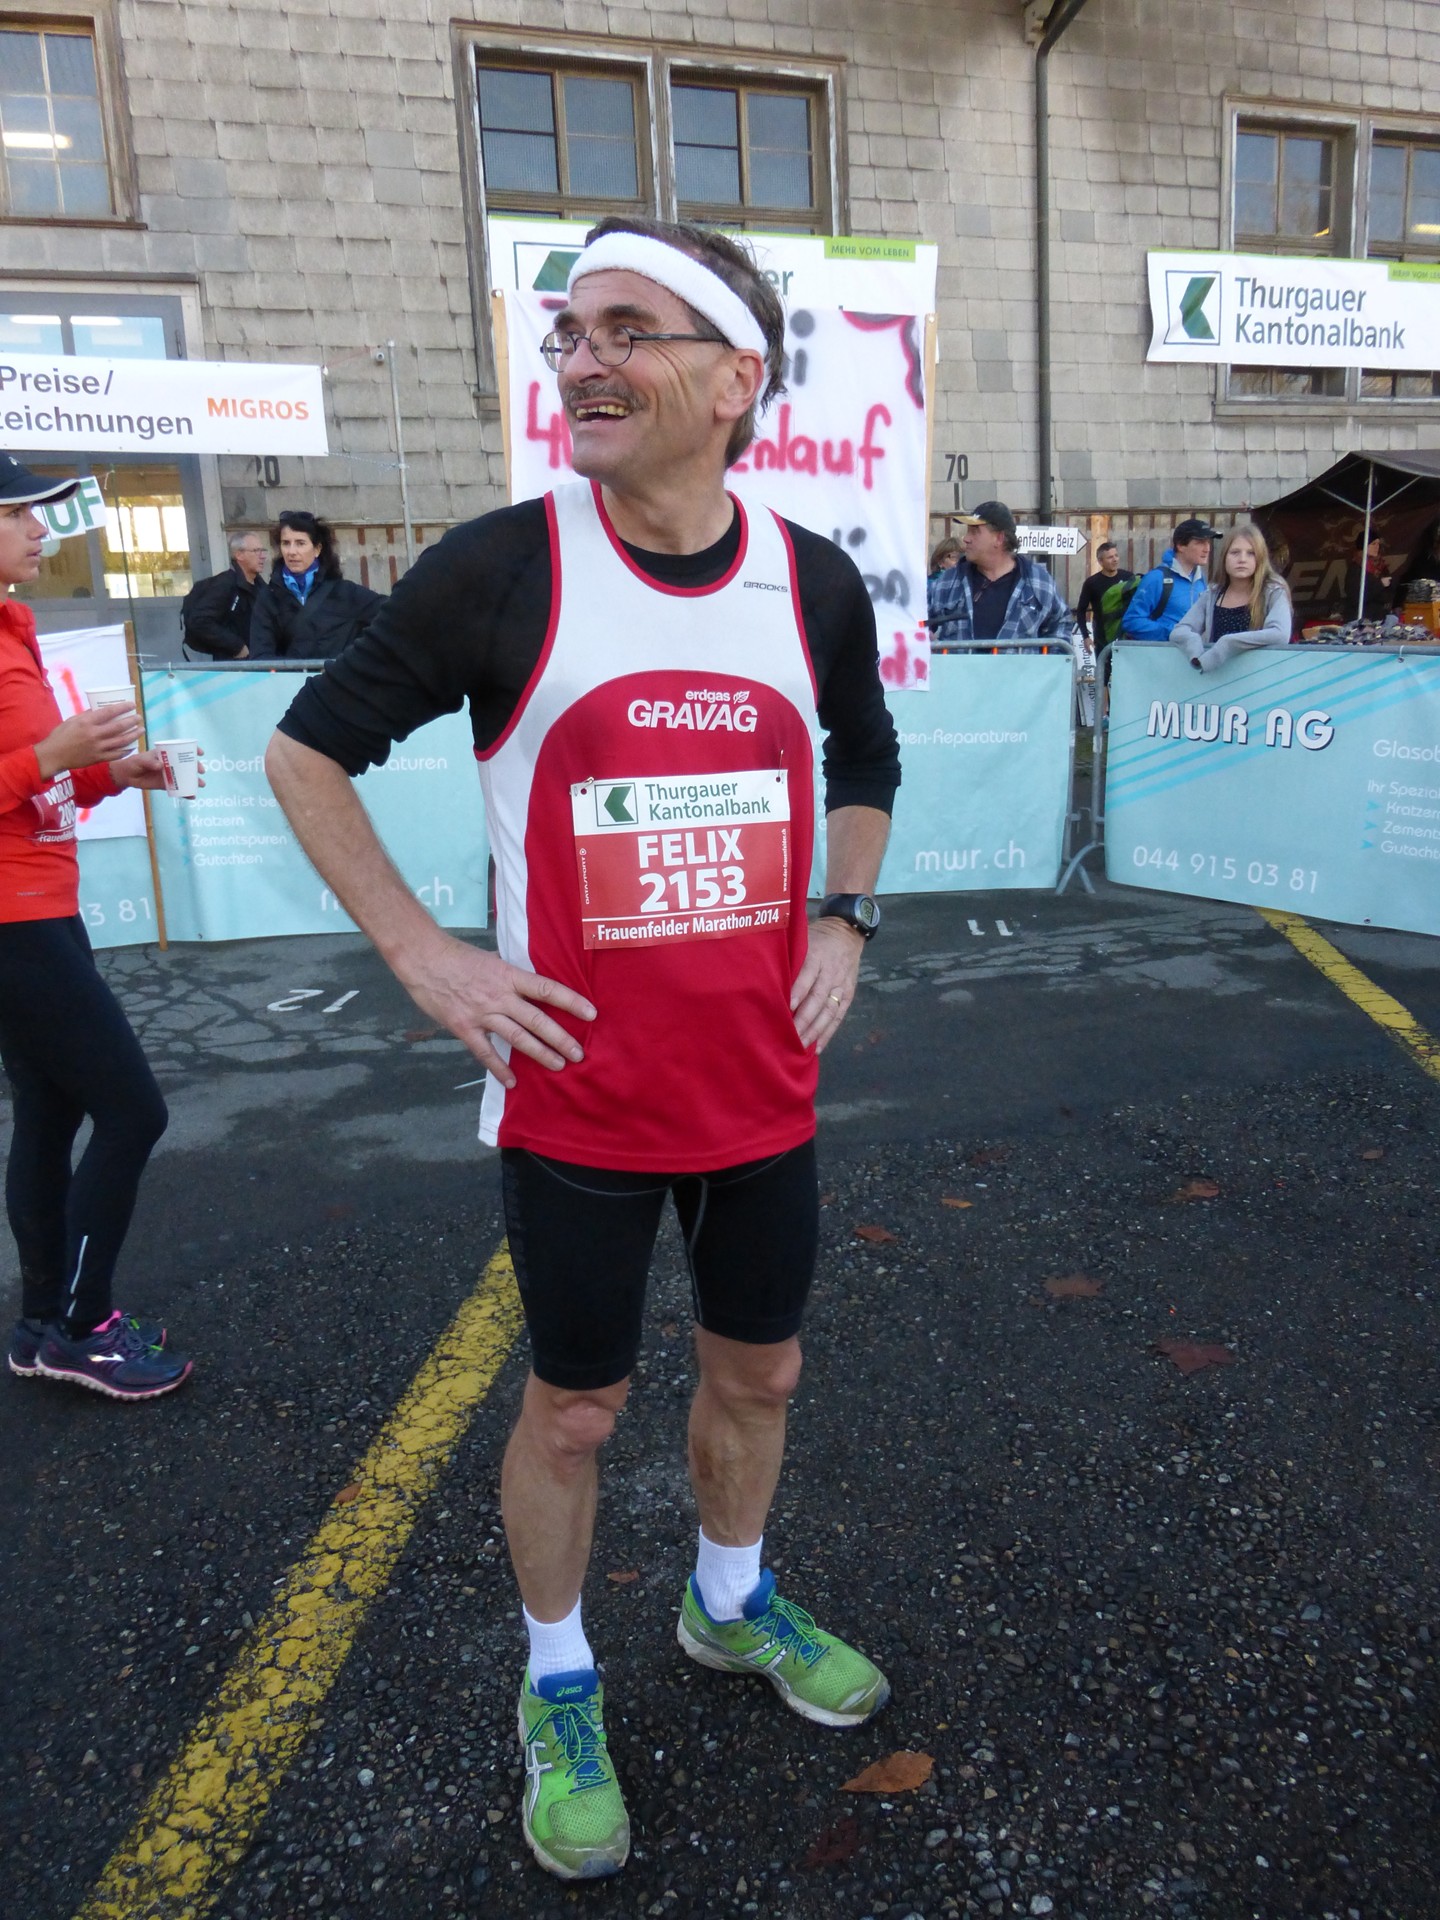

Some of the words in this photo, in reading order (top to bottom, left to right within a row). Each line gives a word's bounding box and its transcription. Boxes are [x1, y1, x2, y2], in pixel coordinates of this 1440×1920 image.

[831, 245, 857, 255] MEHR
[859, 246, 880, 256] VOM
[883, 247, 909, 257] LEBEN
[1235, 276, 1367, 317] Thurgauer
[1235, 313, 1406, 349] Kantonalbank
[0, 365, 114, 396] Preise/
[0, 404, 194, 440] eichnungen
[207, 397, 310, 421] MIGROS
[945, 453, 969, 482] 70
[43, 479, 102, 535] UF
[1018, 532, 1055, 548] enfelder
[1056, 533, 1075, 548] Beiz
[743, 581, 788, 593] BROOKS
[685, 689, 731, 703] erdgas
[627, 699, 758, 733] GRAVAG
[1147, 700, 1249, 744] MWR
[1265, 708, 1335, 750] AG
[898, 728, 1028, 748] hen-Reparaturen
[645, 781, 739, 803] Thurgauer
[1367, 780, 1386, 793] Ihr
[189, 796, 256, 811] Spezialist
[648, 796, 771, 822] Kantonalbank
[189, 815, 246, 828] Kratzern
[191, 834, 288, 849] Zementspuren
[637, 828, 744, 869] FELIX
[193, 853, 264, 867] Gutachten
[915, 840, 1026, 872] mwr.ch
[1132, 846, 1180, 871] 044
[1190, 853, 1237, 880] 915
[1247, 861, 1279, 886] 03
[1289, 868, 1319, 894] 81
[638, 865, 747, 914] 2153
[118, 897, 151, 922] 81
[597, 920, 690, 941] Frauenfelder
[692, 913, 752, 935] Marathon
[754, 908, 780, 925] 2014
